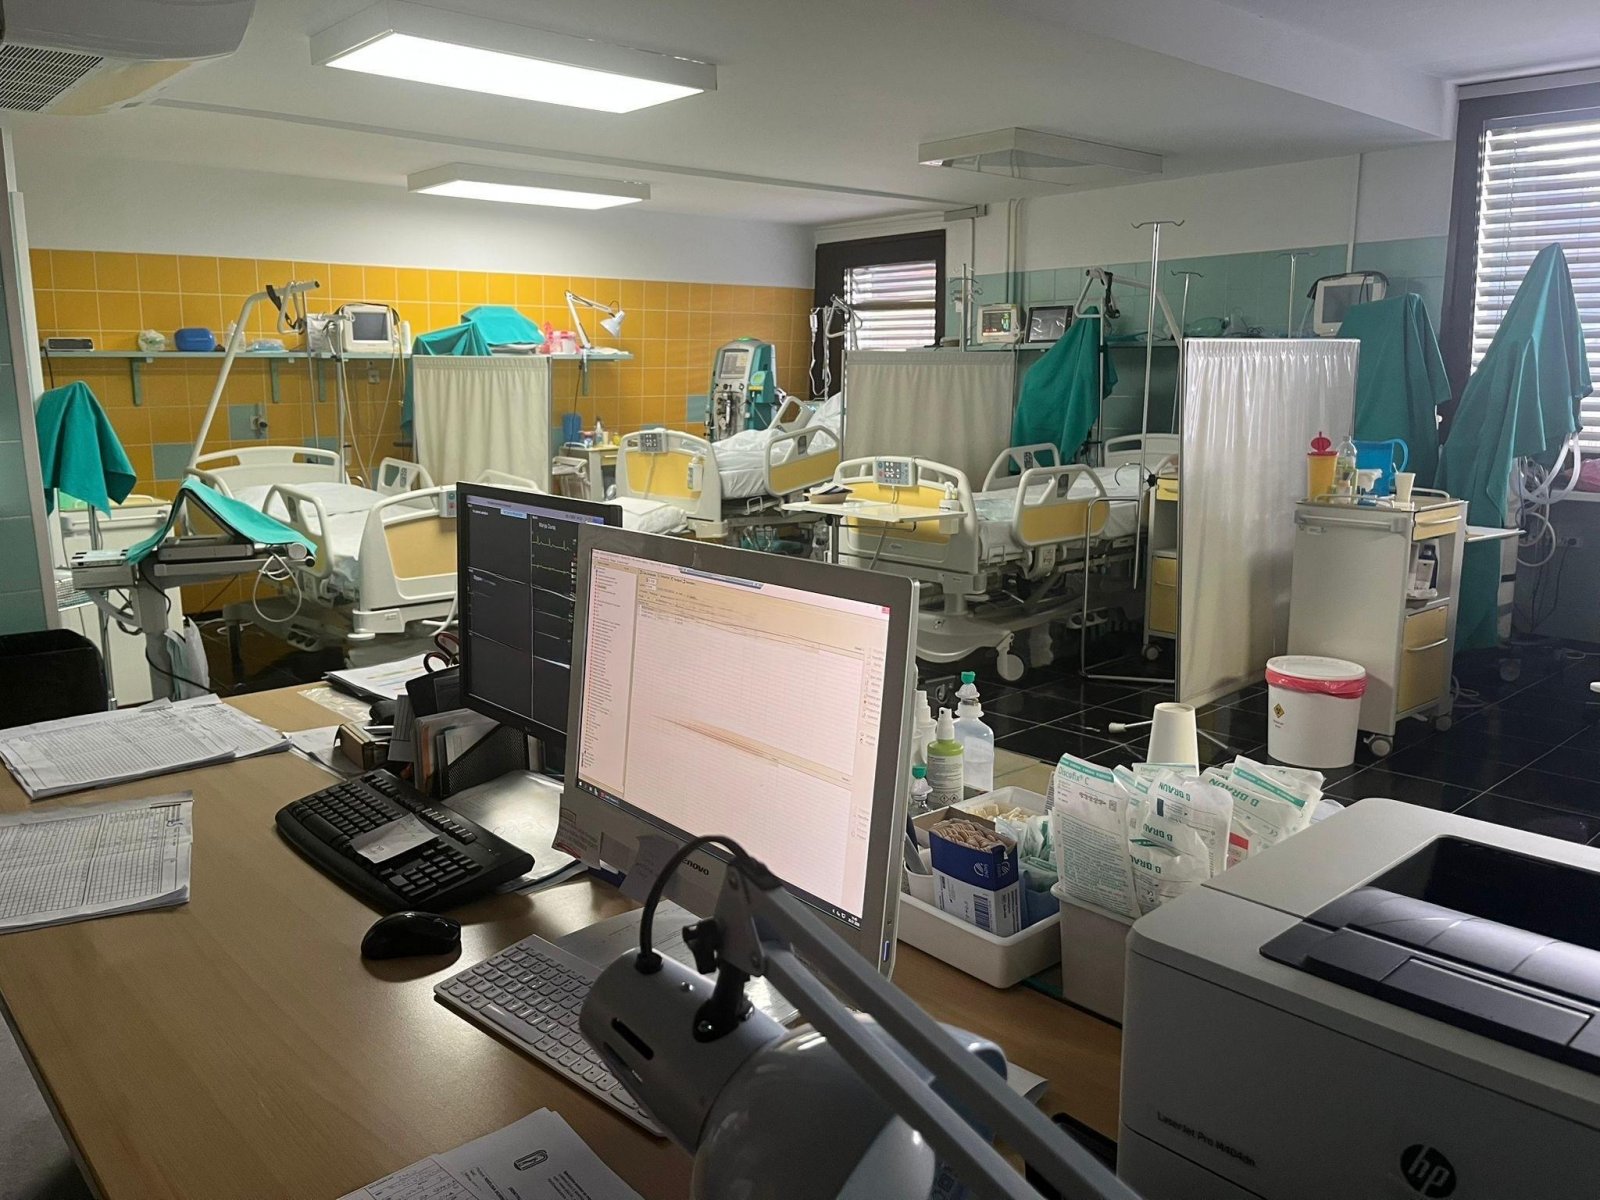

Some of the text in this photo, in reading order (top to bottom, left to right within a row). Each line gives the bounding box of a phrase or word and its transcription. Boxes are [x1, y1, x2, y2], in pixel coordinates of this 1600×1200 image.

[1159, 782, 1184, 799] BRAUN
[682, 857, 710, 876] enovo
[1157, 1111, 1195, 1138] LaserJet
[1197, 1131, 1213, 1146] Pro
[1404, 1144, 1453, 1197] hp
